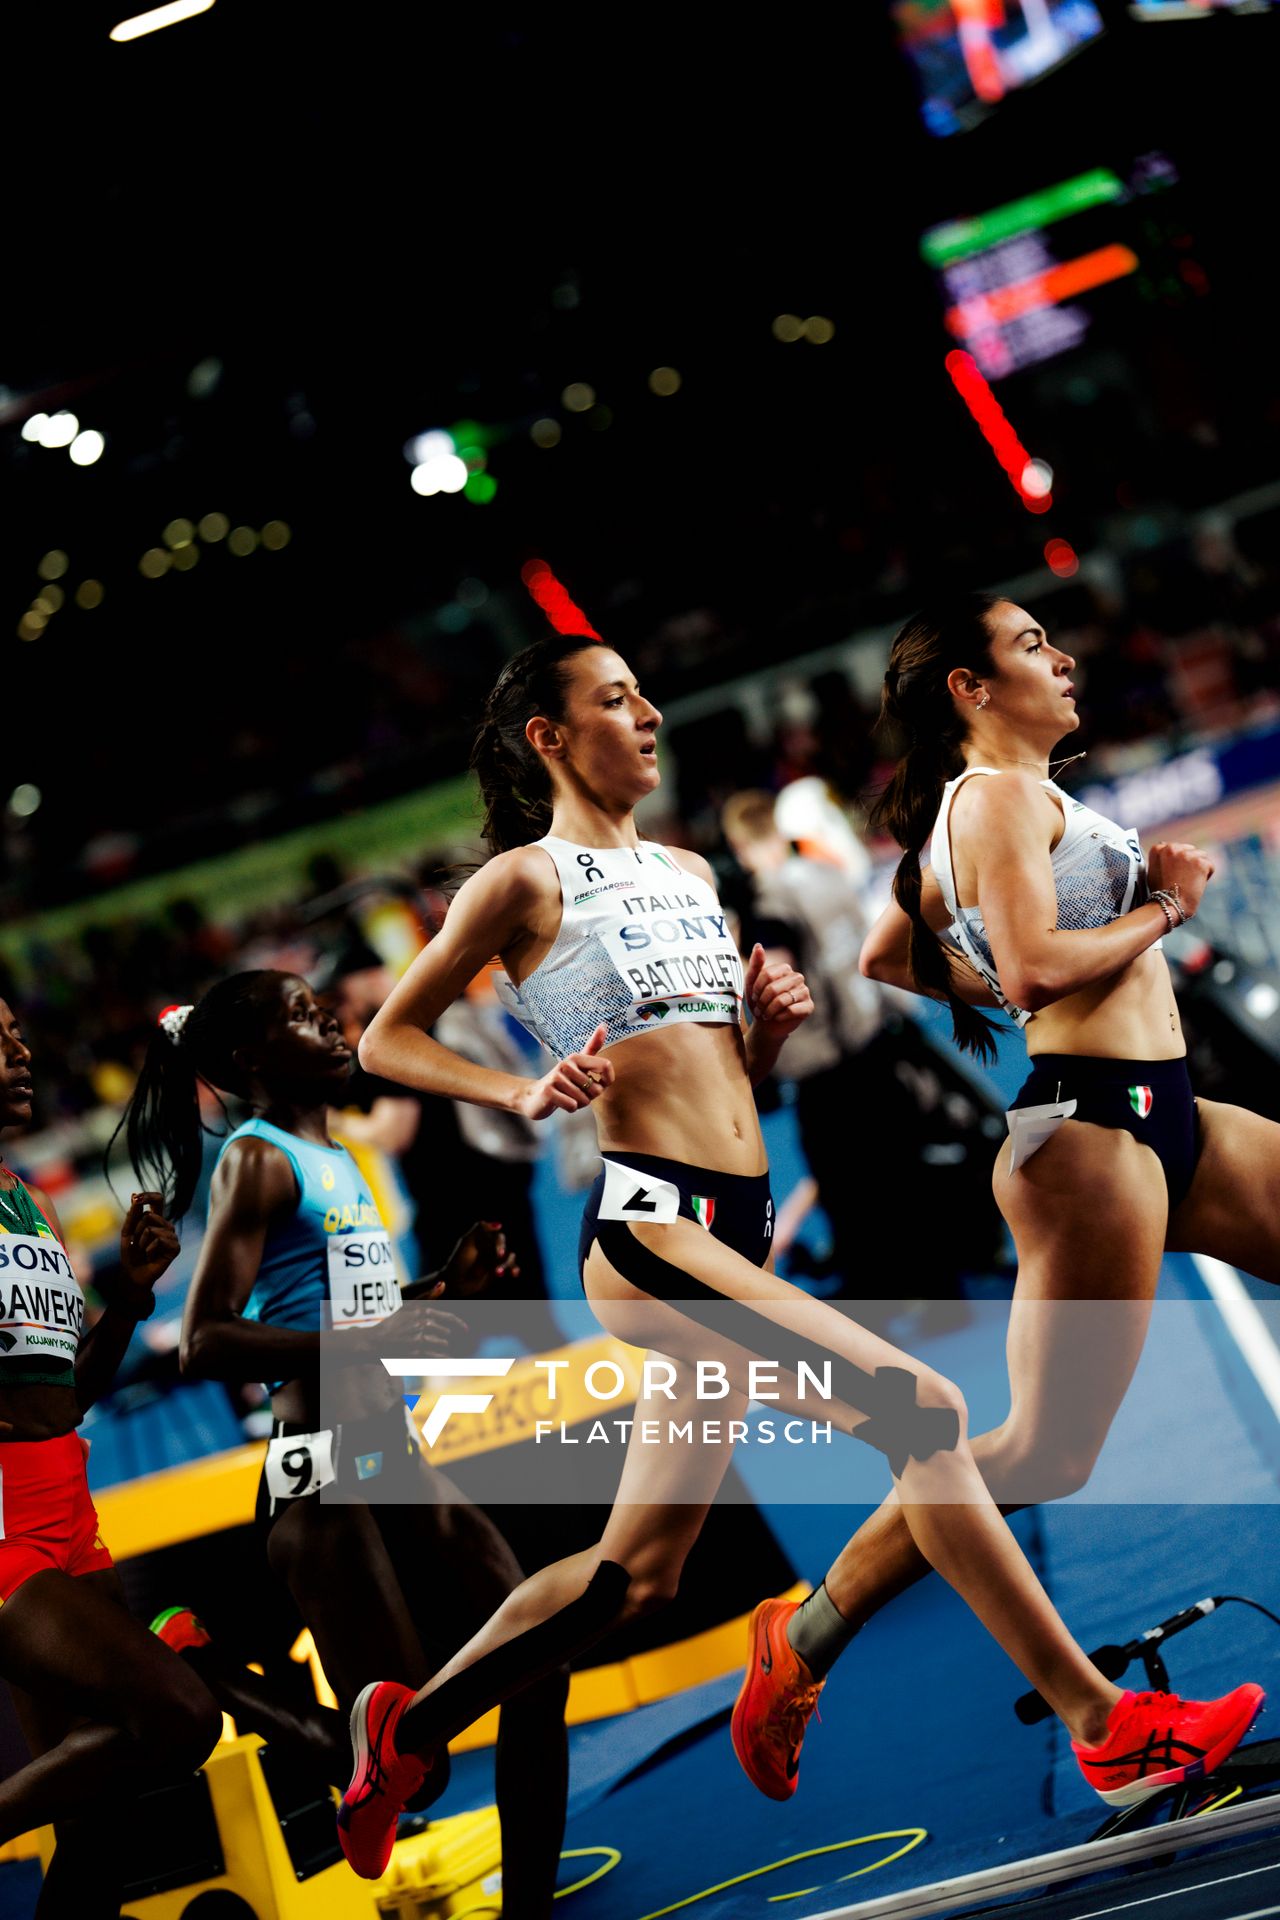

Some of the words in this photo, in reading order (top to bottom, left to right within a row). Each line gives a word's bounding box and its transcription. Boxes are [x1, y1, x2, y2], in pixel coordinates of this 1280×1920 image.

[574, 881, 635, 902] FRECCIAROSSA
[622, 894, 700, 915] ITALIA
[619, 915, 727, 951] SONY
[678, 1002, 720, 1013] KUJAWY
[25, 1335, 58, 1348] KUJAWY
